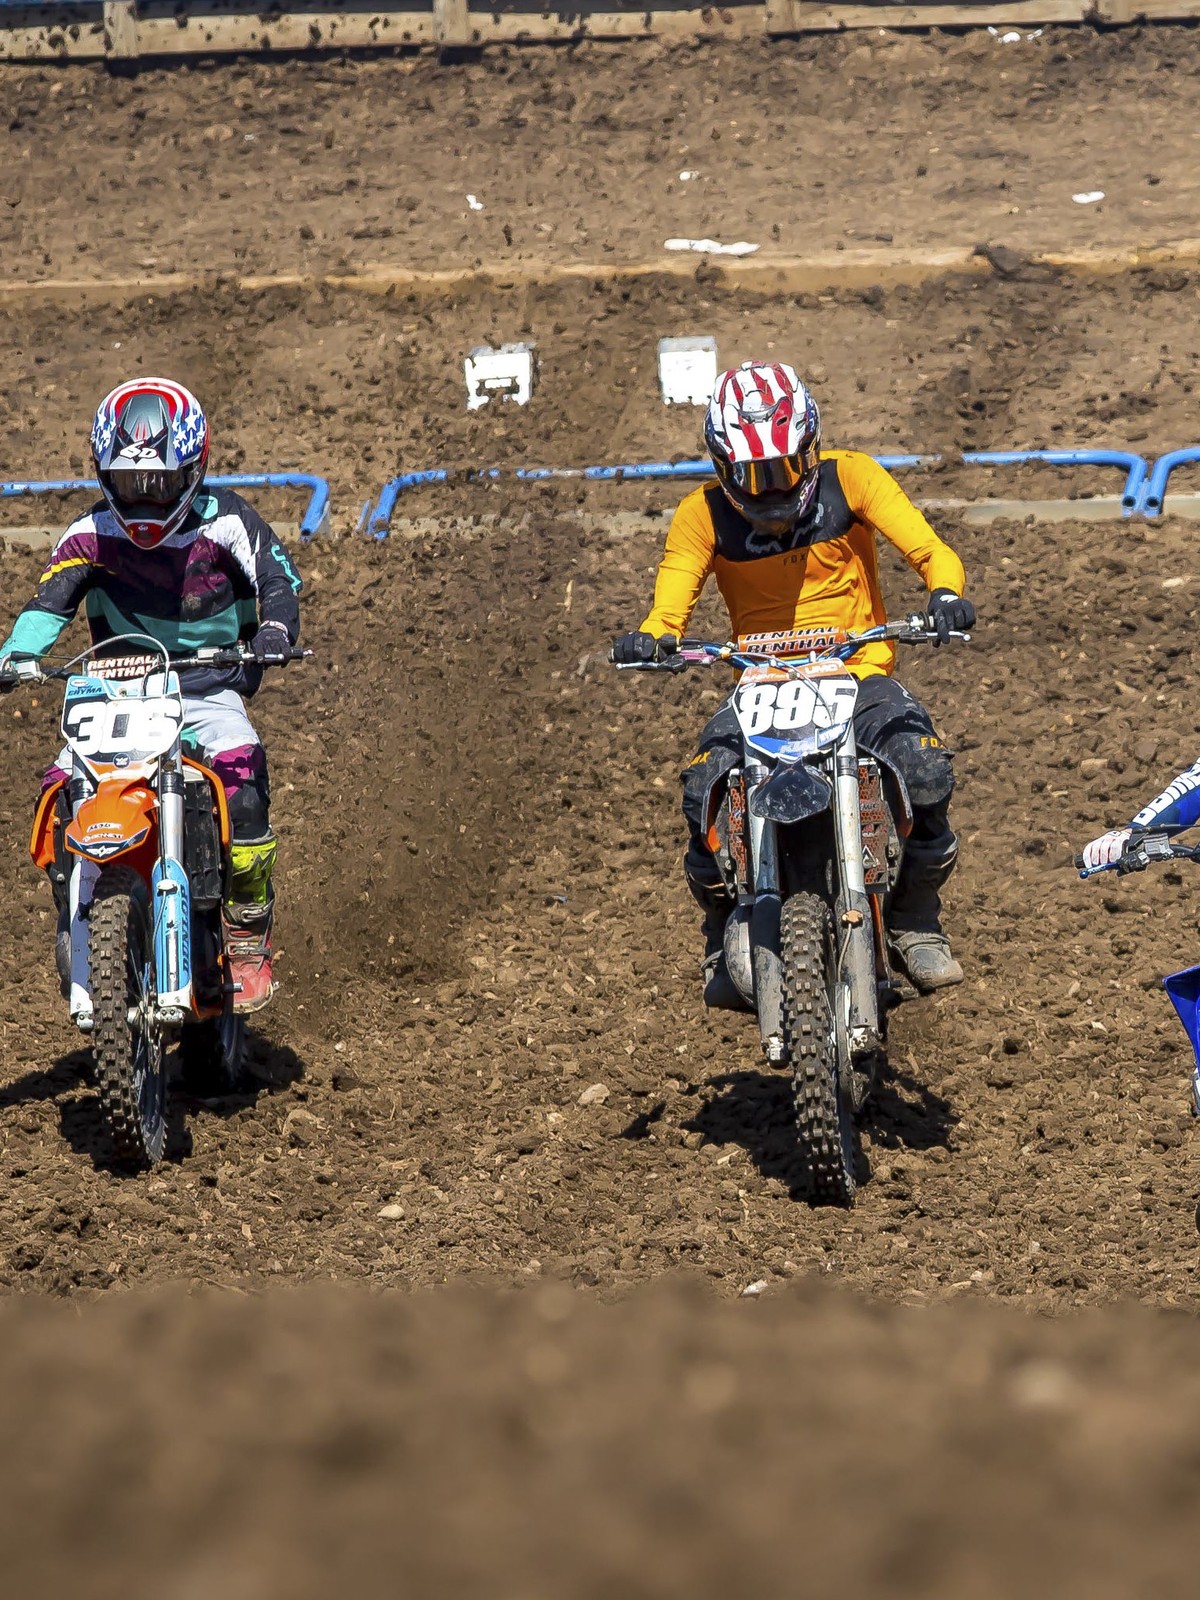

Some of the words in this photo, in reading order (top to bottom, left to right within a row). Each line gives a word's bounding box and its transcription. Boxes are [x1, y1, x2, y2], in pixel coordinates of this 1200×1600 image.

[747, 637, 837, 653] RENTHAL
[739, 680, 857, 735] 895
[180, 884, 189, 973] DUNLOP
